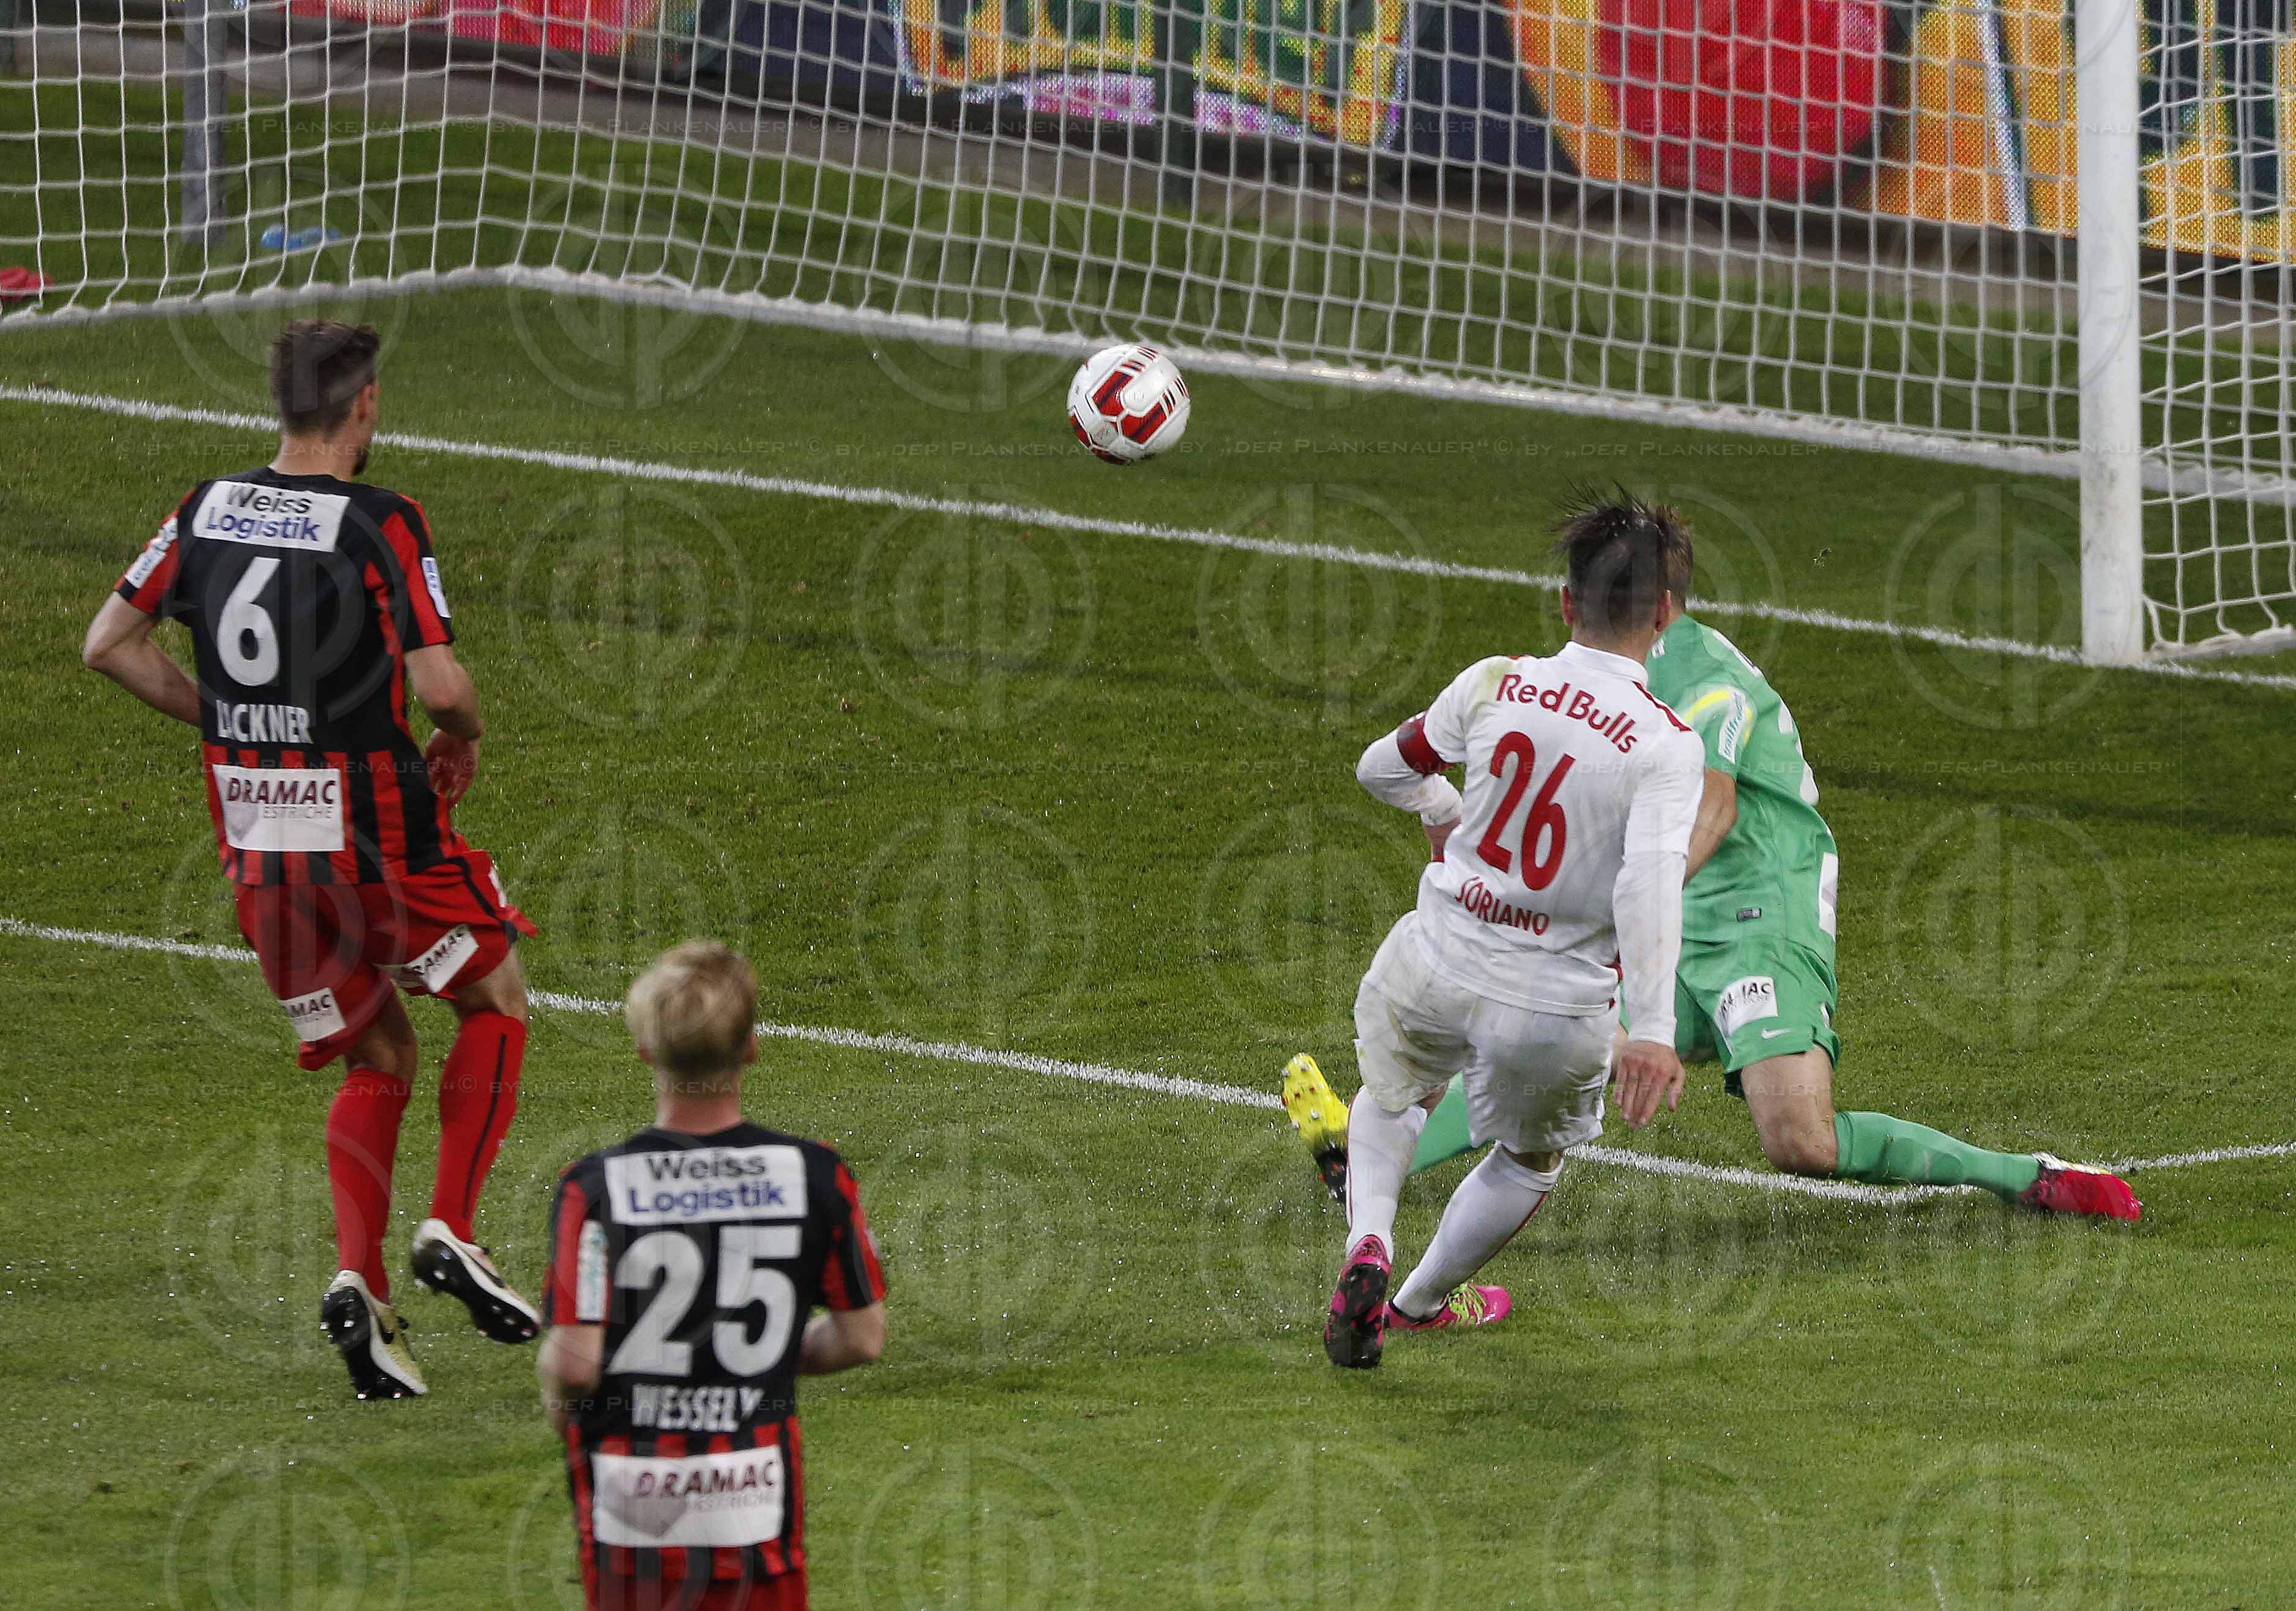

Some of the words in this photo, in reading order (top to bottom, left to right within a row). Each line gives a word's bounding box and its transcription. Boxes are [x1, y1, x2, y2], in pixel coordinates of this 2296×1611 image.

[227, 484, 313, 514] Weiss
[206, 506, 322, 541] Logistik
[217, 556, 281, 687] 6
[1496, 673, 1571, 712] Red
[1566, 690, 1638, 754] Bulls
[226, 777, 337, 805] DRAMAC
[1477, 730, 1577, 892] 26
[645, 1145, 767, 1179] Weiss
[628, 1180, 784, 1215] Logistik
[606, 1225, 803, 1377] 25
[634, 1459, 776, 1498] DRAMAC
